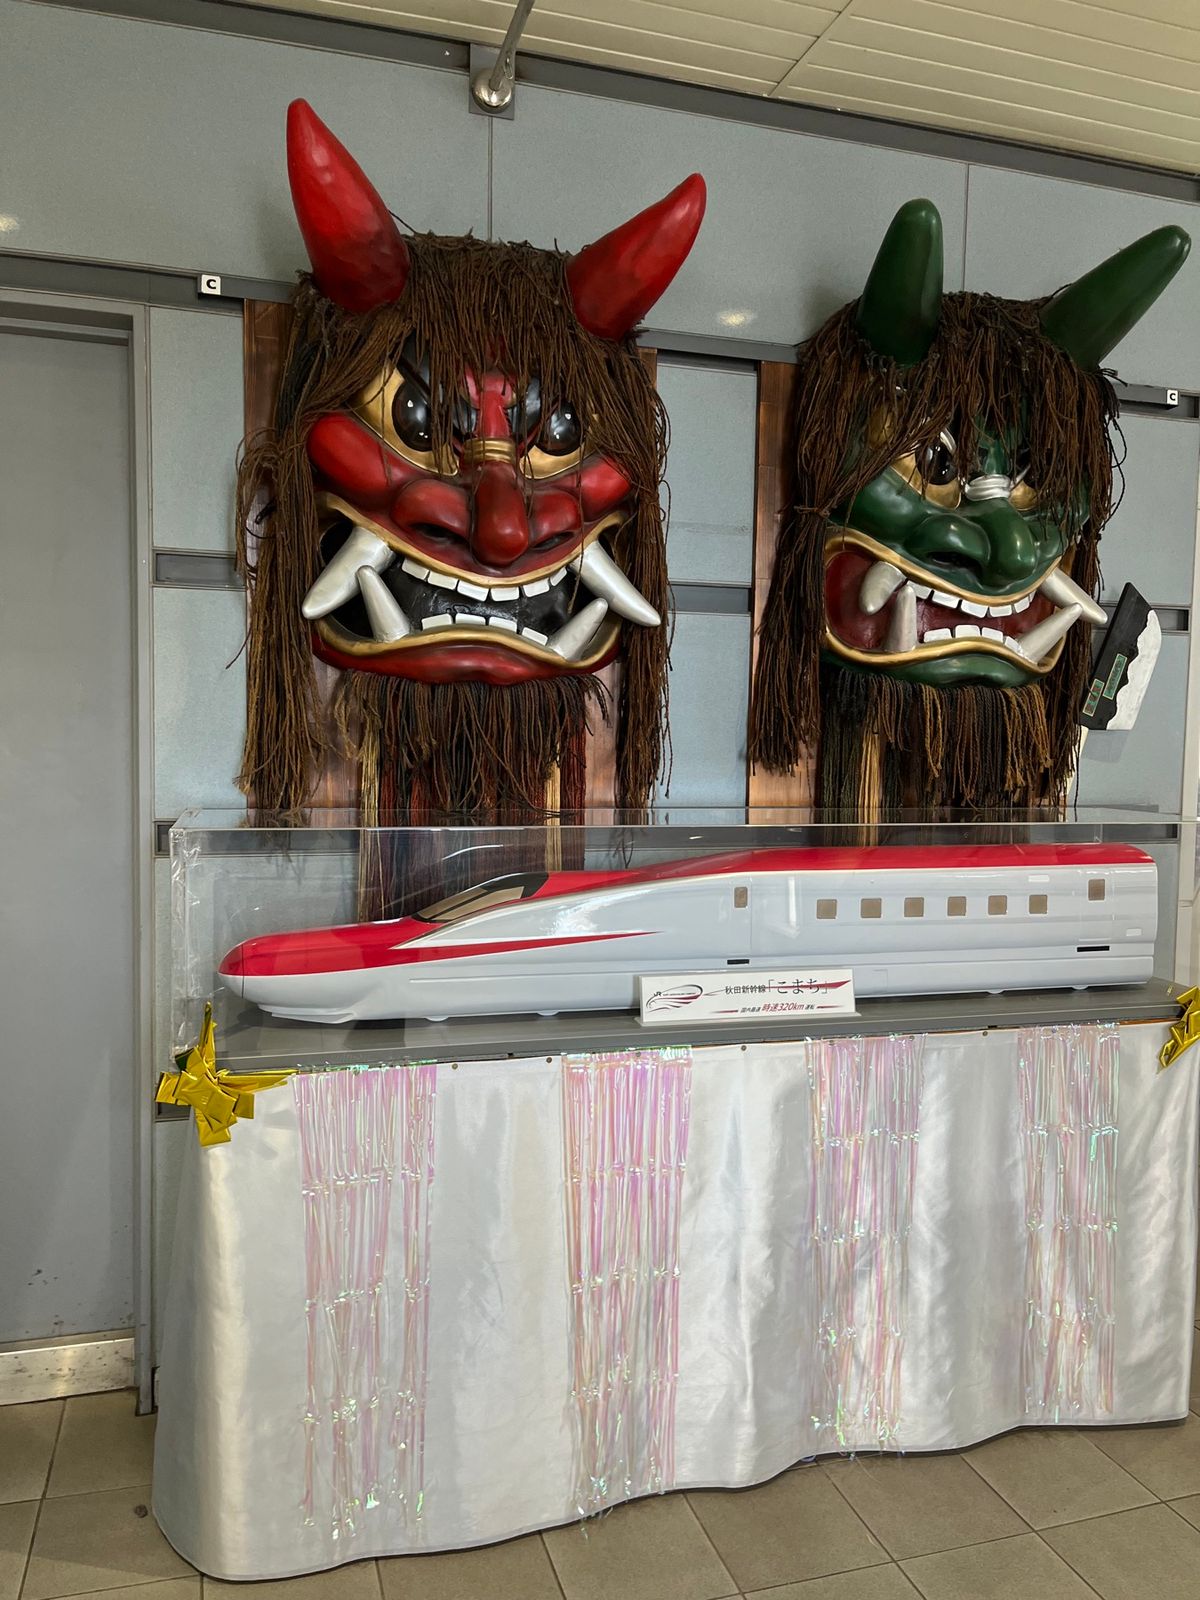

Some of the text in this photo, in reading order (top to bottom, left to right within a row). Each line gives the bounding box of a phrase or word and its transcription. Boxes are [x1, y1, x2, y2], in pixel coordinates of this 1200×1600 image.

[206, 279, 217, 290] C
[1169, 392, 1177, 402] C
[725, 978, 827, 994] 秋田新幹線「こまち」
